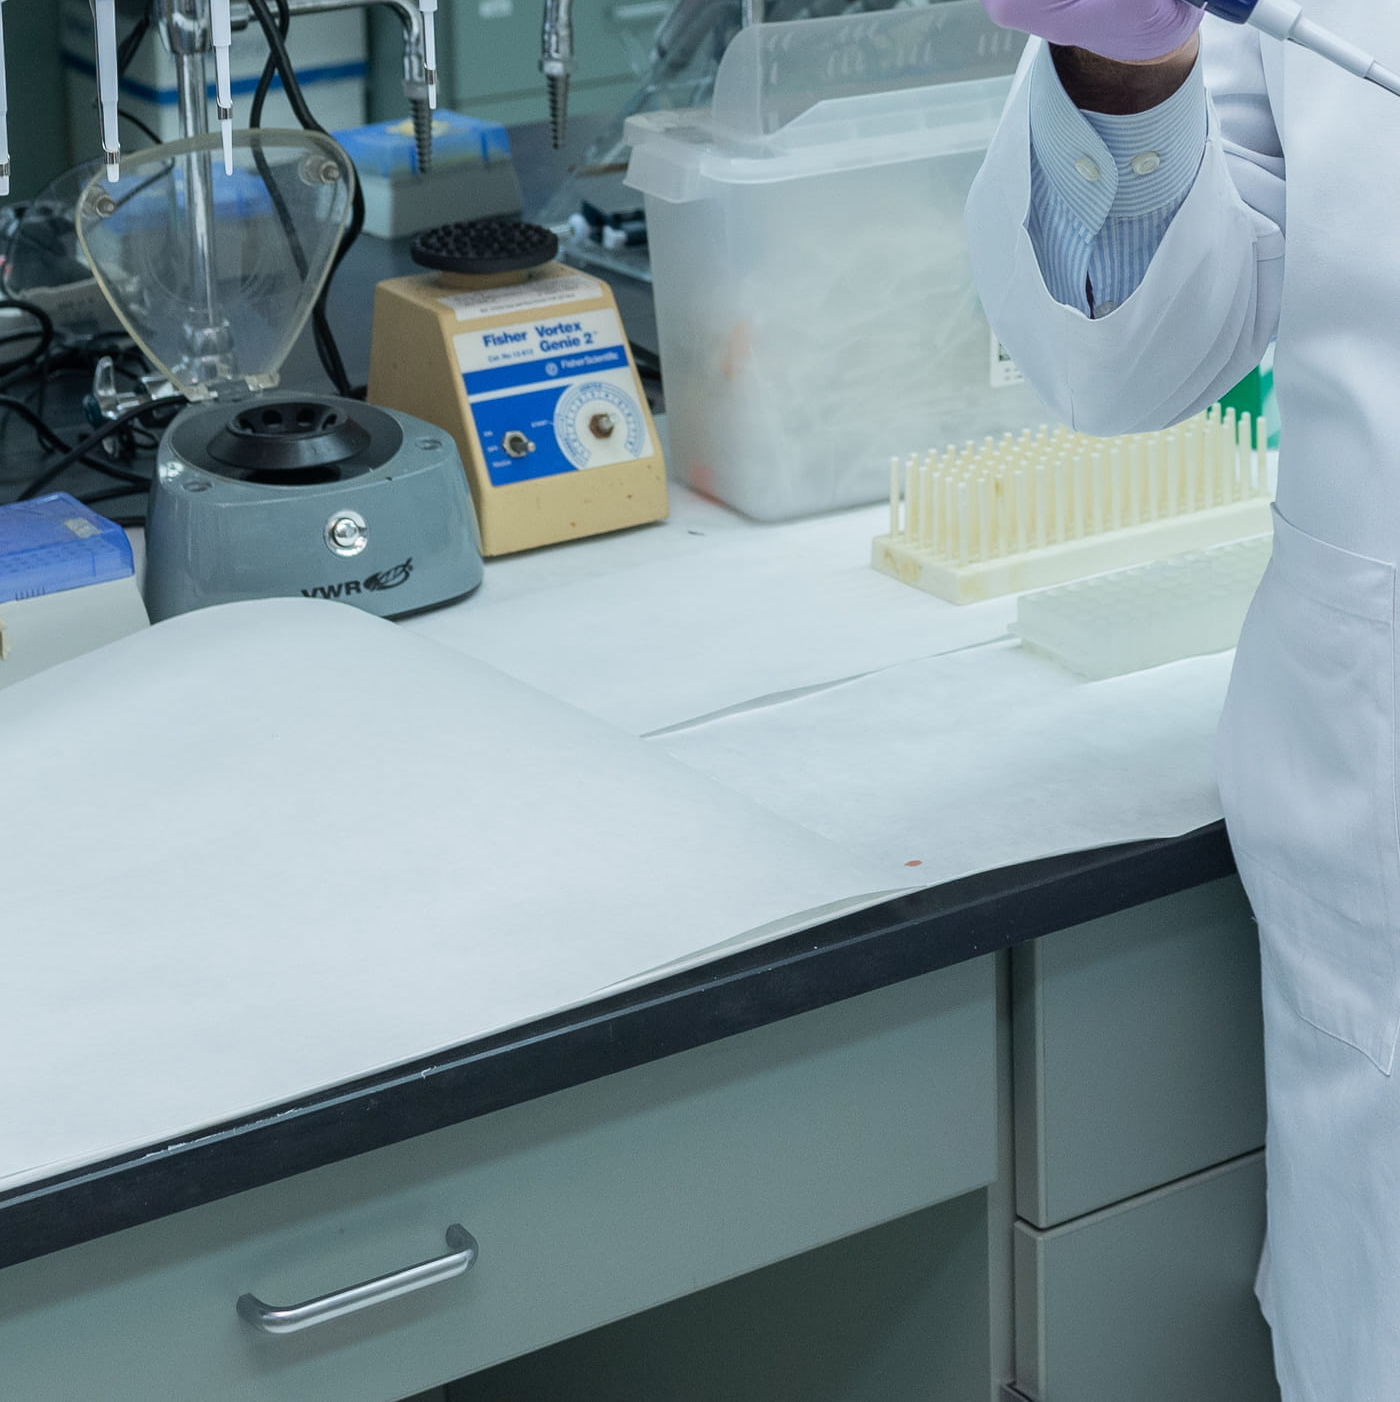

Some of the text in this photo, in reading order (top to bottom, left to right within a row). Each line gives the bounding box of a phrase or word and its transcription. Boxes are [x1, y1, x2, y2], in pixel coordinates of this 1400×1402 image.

[482, 321, 582, 348] Fisher Vortex
[539, 333, 594, 353] Genie 2
[301, 580, 362, 599] VWR
